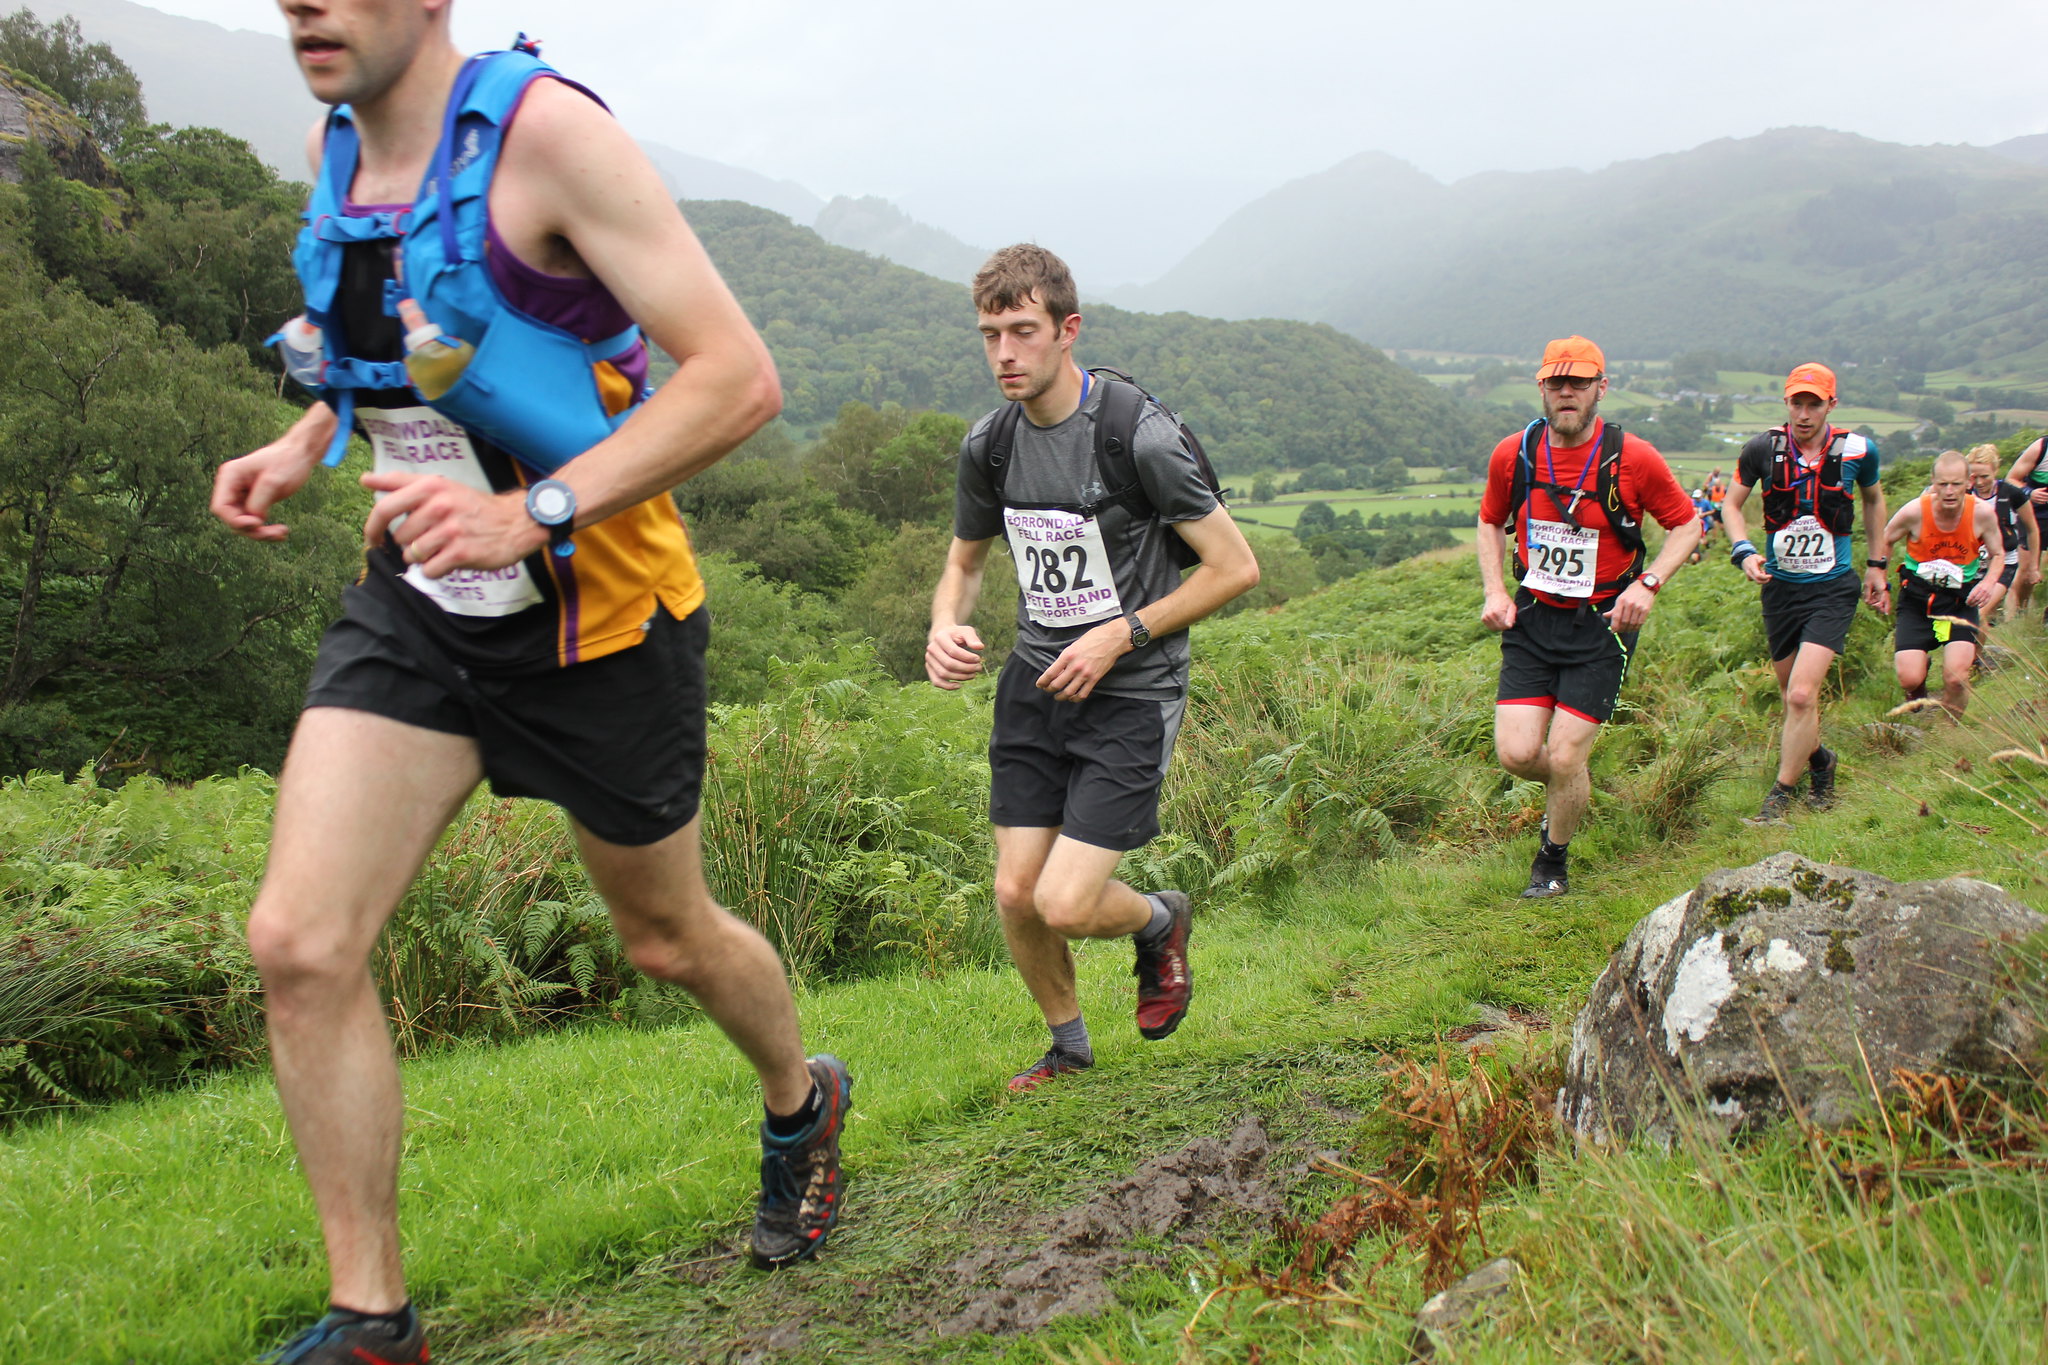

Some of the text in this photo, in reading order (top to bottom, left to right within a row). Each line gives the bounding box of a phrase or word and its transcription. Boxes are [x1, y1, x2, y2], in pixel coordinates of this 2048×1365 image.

[406, 441, 464, 463] RACE
[1018, 527, 1086, 543] FELL RACE
[1535, 531, 1588, 546] FELL RACE
[1783, 533, 1824, 557] 222
[1025, 545, 1094, 594] 282
[1538, 544, 1584, 577] 295
[1802, 556, 1833, 565] BLAND
[1055, 588, 1112, 608] BLAND
